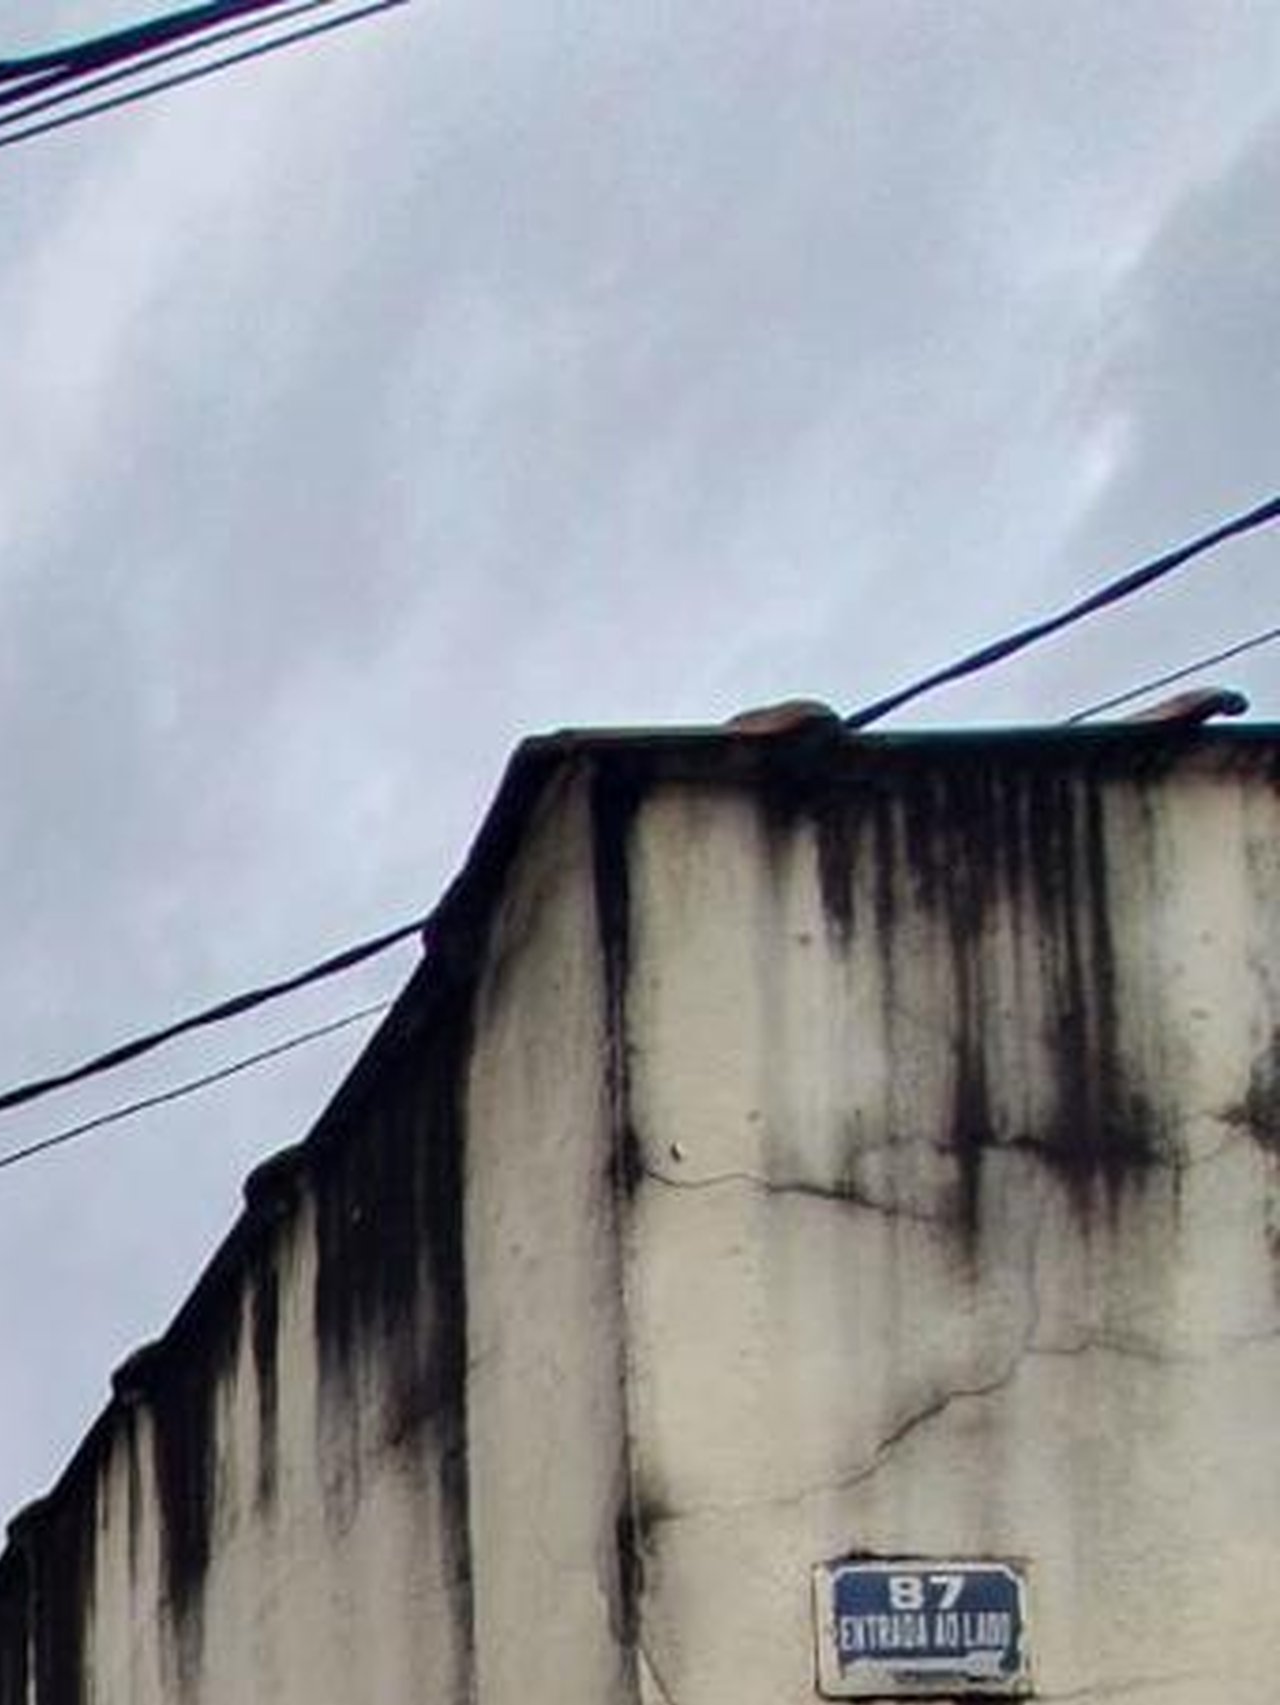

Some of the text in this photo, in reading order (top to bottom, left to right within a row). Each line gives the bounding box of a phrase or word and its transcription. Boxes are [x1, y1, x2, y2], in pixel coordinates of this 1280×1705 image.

[889, 1575, 966, 1611] 87
[839, 1612, 928, 1652] ENTRADA
[935, 1611, 960, 1649] AO
